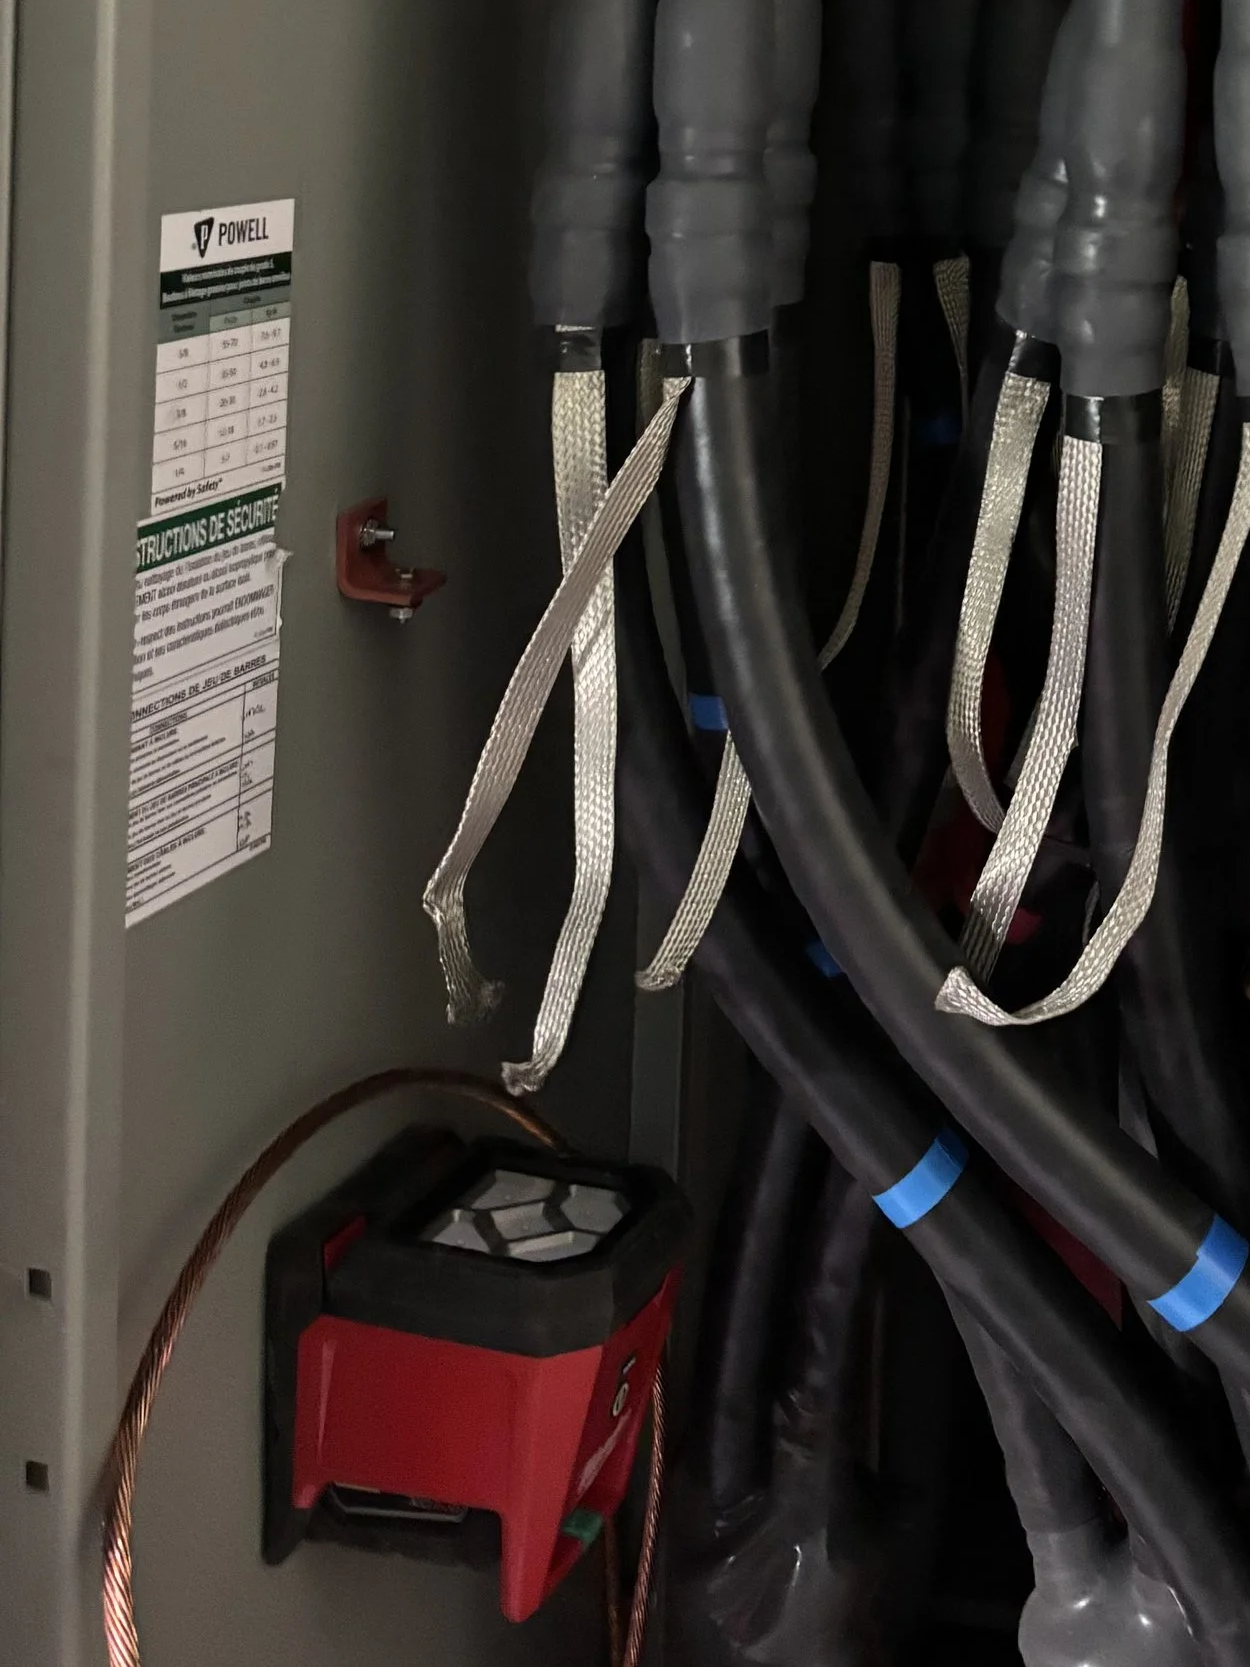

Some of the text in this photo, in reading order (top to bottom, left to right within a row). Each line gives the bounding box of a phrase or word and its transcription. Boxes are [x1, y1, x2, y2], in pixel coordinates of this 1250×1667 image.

[218, 217, 269, 246] POWELL
[154, 492, 186, 508] Powered
[187, 487, 196, 499] by
[208, 512, 226, 543] DE
[188, 682, 200, 696] DE
[202, 675, 219, 689] JEU
[220, 668, 232, 681] DE
[233, 654, 267, 677] BARRES
